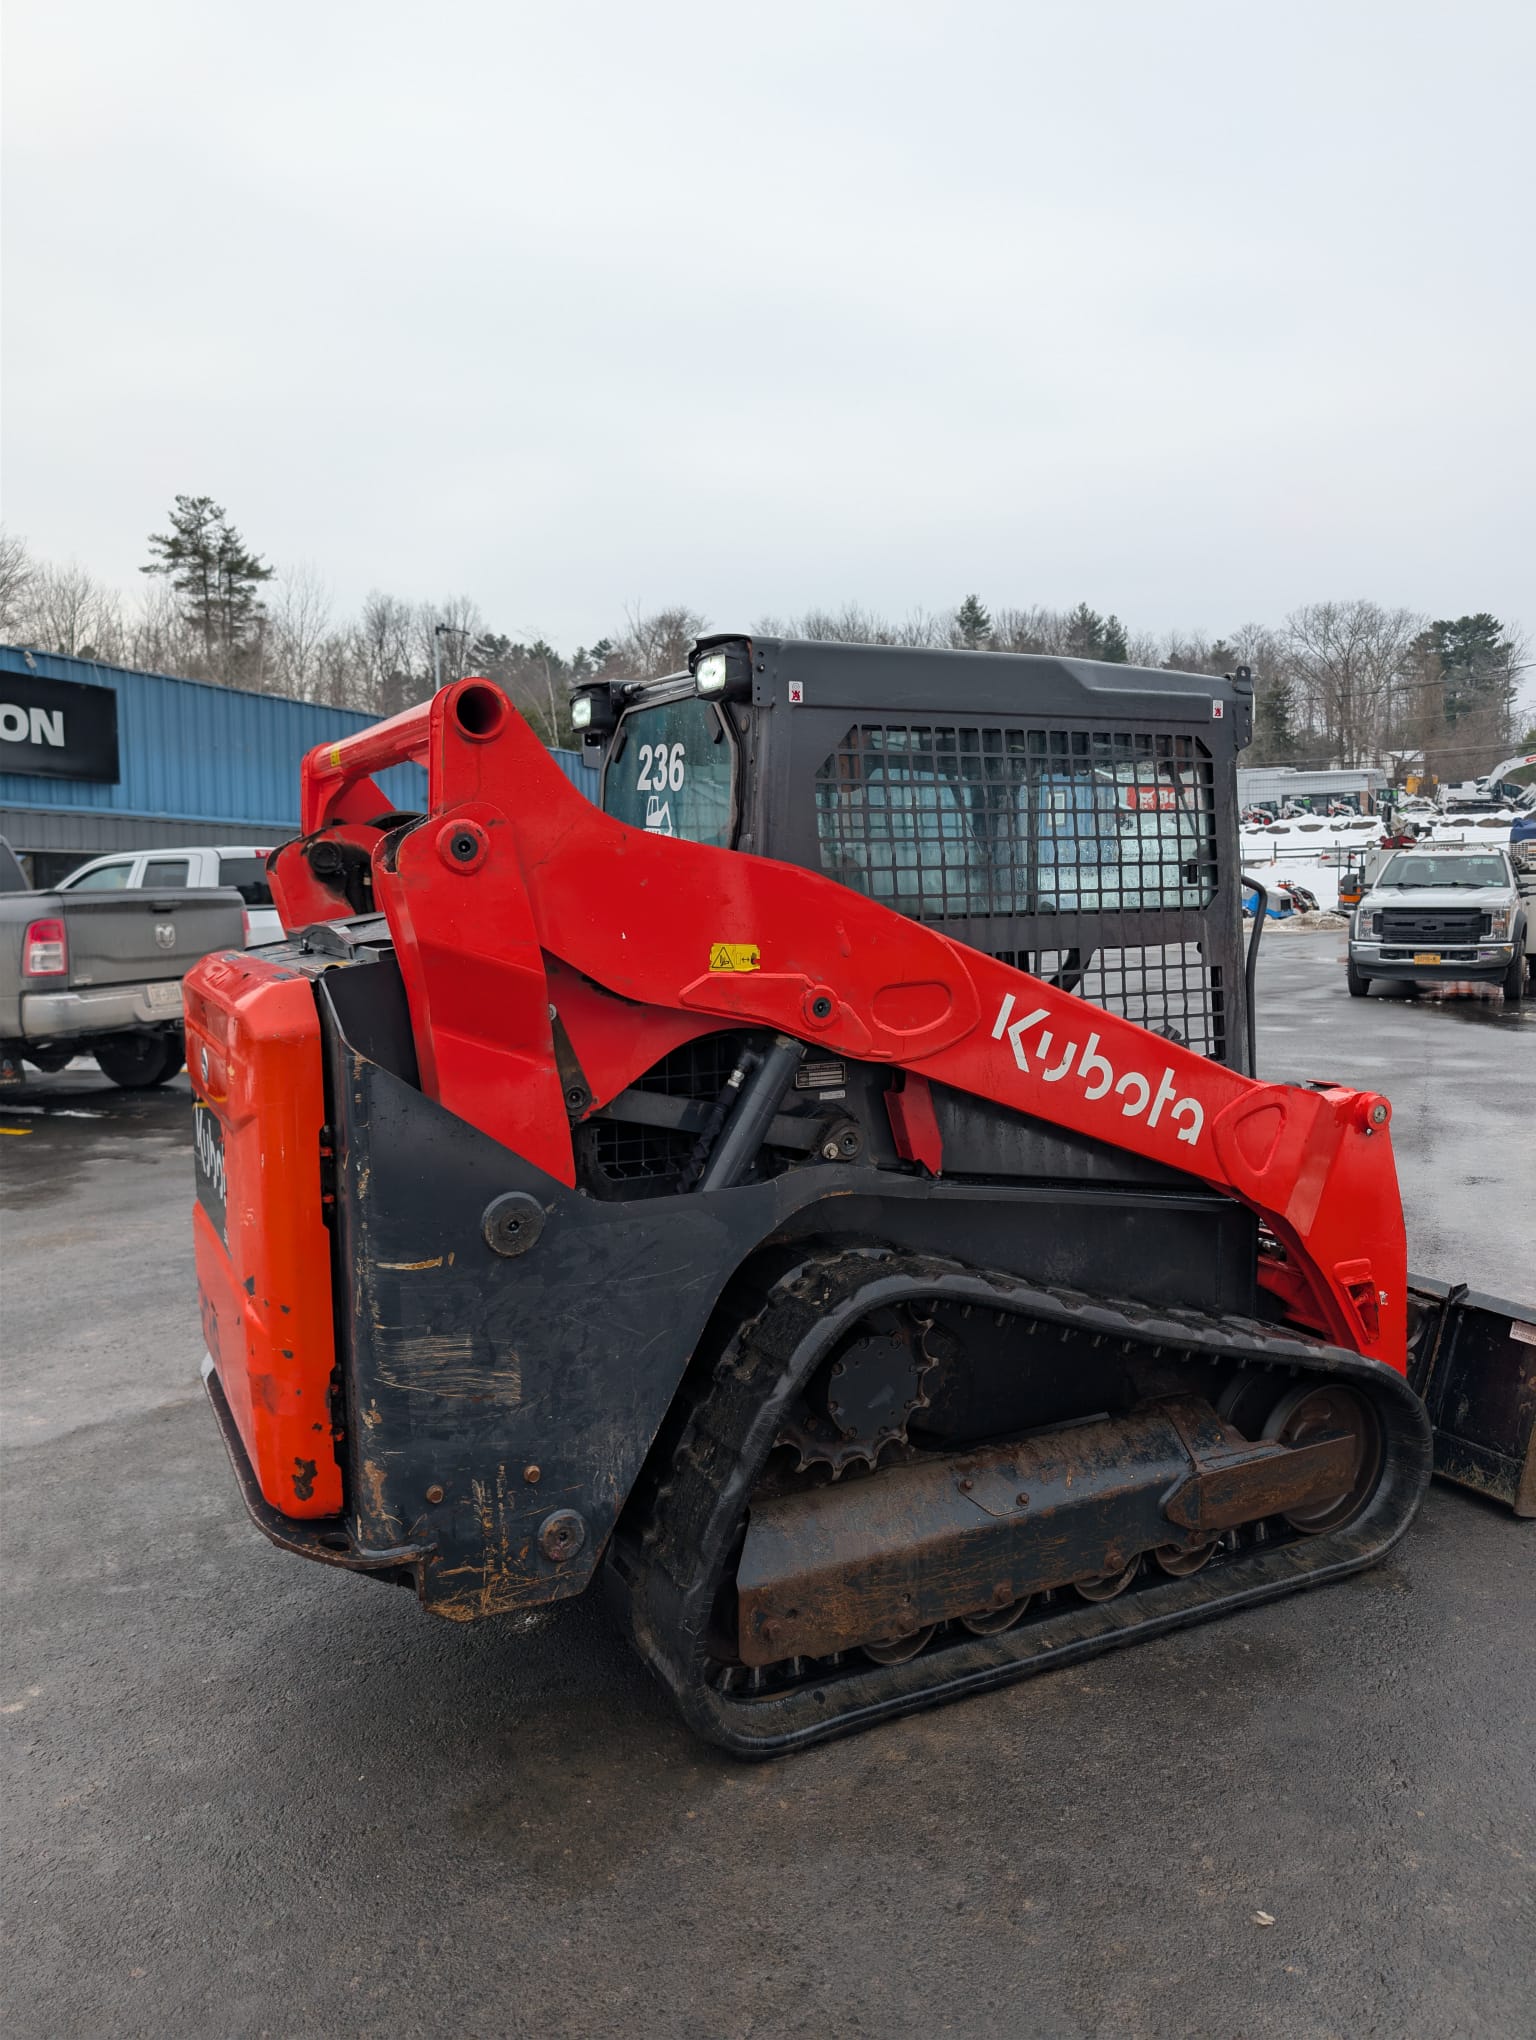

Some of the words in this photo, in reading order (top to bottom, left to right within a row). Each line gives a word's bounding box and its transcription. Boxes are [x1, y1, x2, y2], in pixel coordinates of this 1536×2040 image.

[0, 703, 65, 747] ON
[637, 743, 685, 791] 236
[991, 993, 1204, 1145] Kubota
